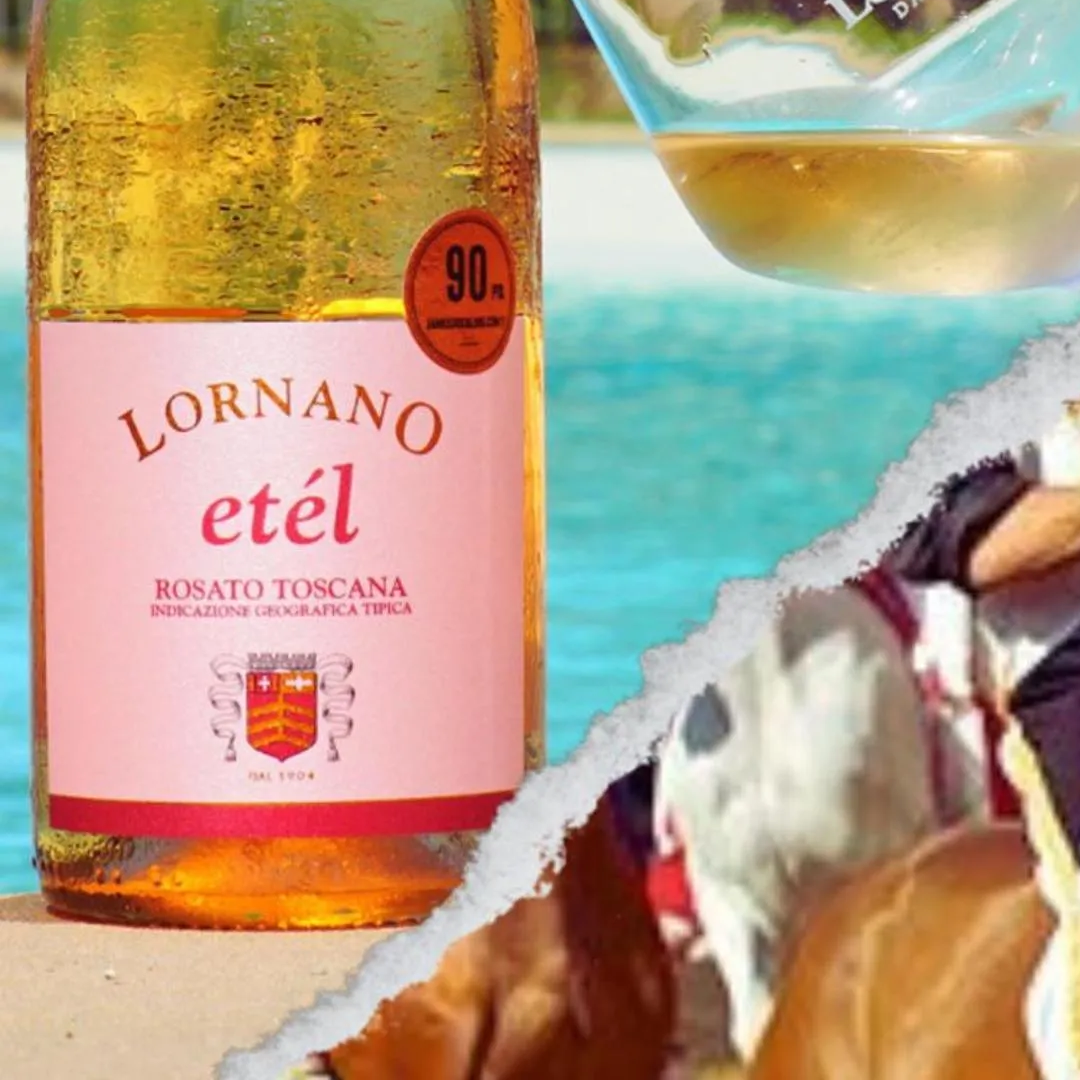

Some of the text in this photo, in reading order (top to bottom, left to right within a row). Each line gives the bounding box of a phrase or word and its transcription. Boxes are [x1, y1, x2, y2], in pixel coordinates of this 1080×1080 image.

[446, 245, 487, 302] 90
[118, 377, 443, 461] LORNANO
[201, 463, 359, 546] etél
[150, 601, 412, 618] INDICAZIONE GEOGRAFICA TIPICA
[155, 576, 408, 600] ROSATO TOSCANA
